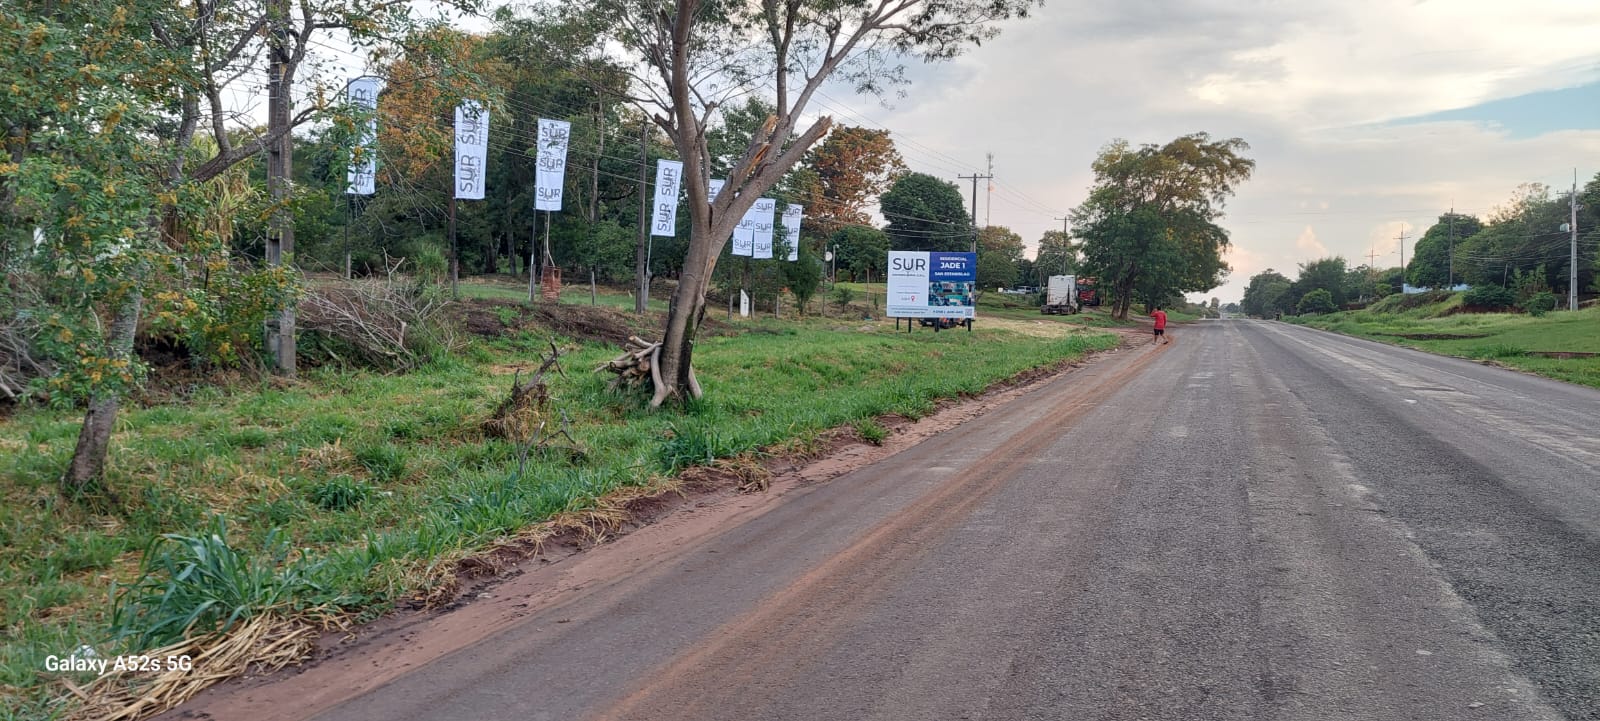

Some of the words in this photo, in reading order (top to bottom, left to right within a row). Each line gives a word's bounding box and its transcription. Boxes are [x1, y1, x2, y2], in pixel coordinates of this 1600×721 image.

[542, 127, 567, 139] SUR
[539, 157, 563, 170] SUR
[460, 154, 475, 192] SUR
[661, 167, 674, 196] SUR
[538, 187, 561, 199] SUR
[756, 202, 773, 211] SUR
[657, 203, 671, 231] SUR
[755, 222, 772, 231] SUR
[734, 238, 752, 248] SUR
[755, 243, 772, 251] SUR
[892, 257, 926, 271] SUR
